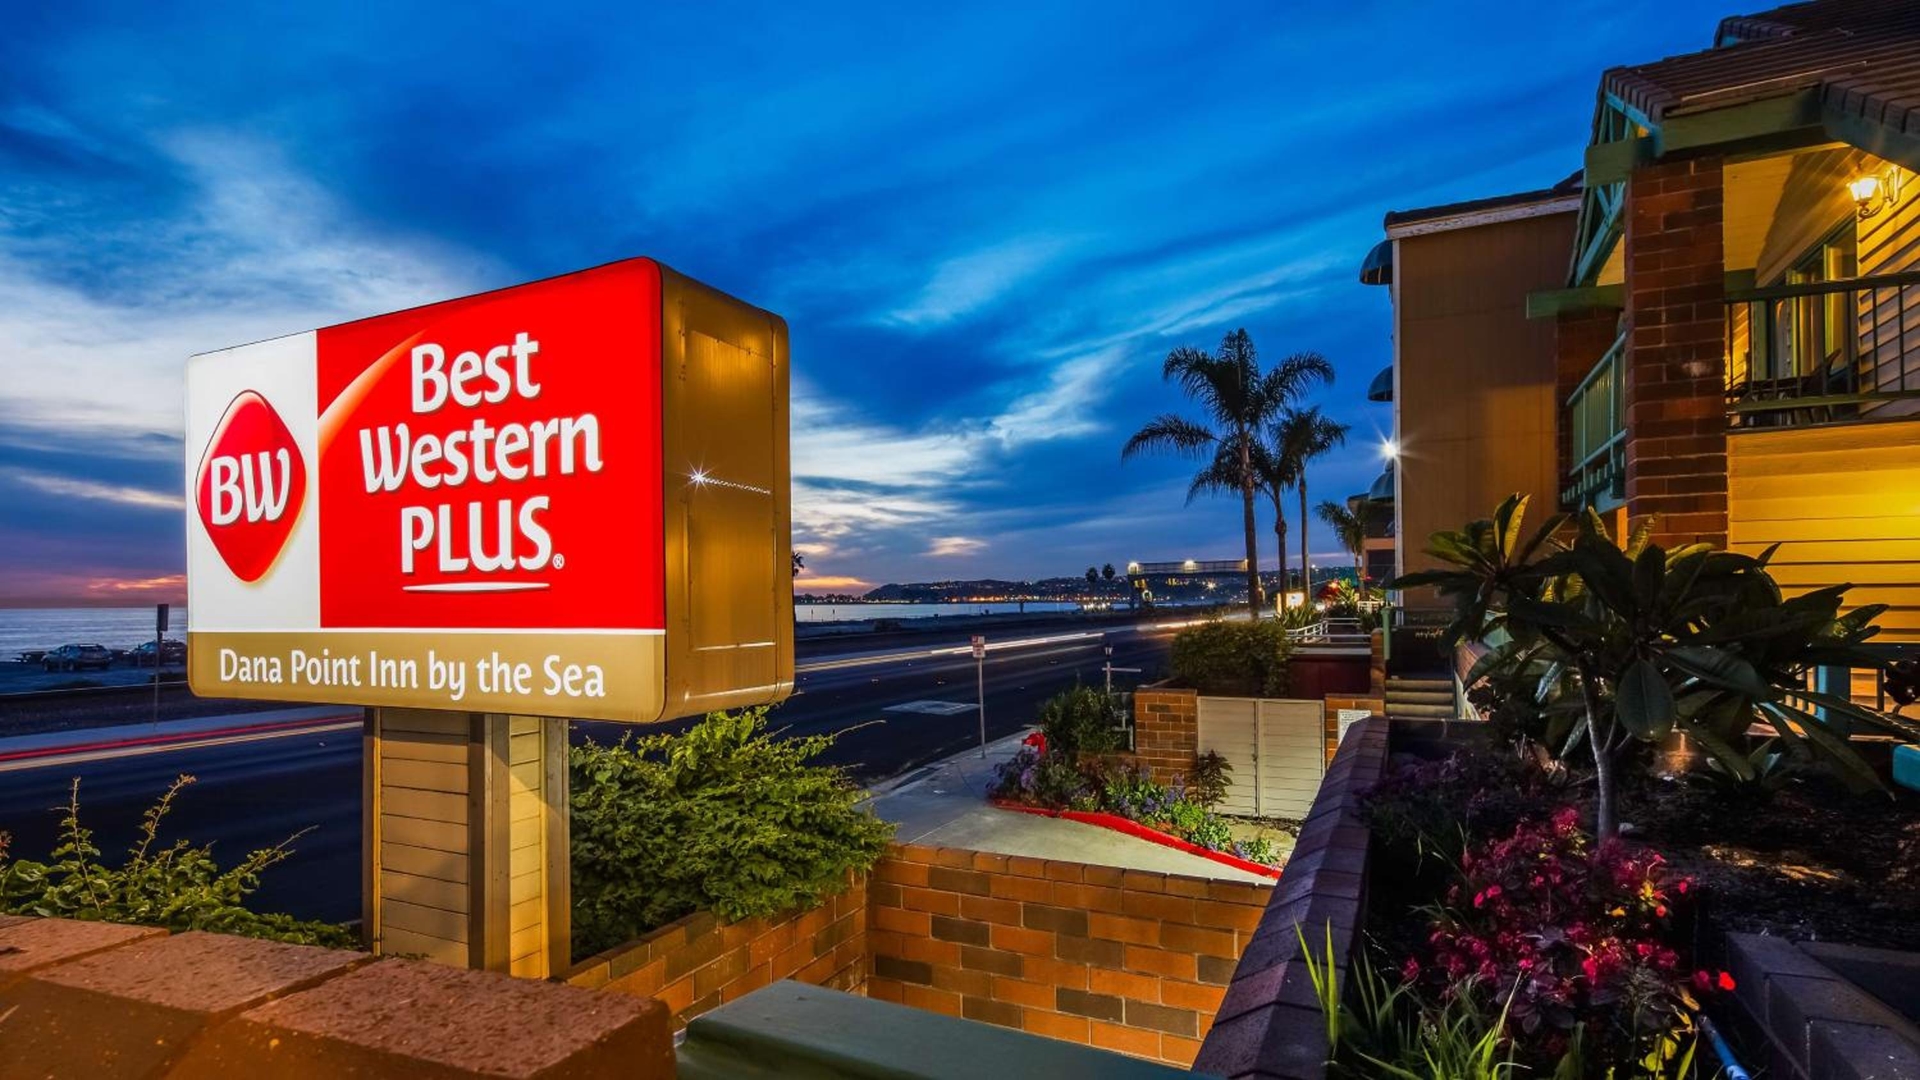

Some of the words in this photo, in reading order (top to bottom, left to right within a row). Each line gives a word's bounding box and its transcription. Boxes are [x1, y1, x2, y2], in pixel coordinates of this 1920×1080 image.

[411, 332, 541, 413] Best
[210, 448, 291, 525] BW
[359, 413, 604, 493] Western
[401, 496, 552, 574] PLUS
[220, 648, 283, 683] Dana
[291, 648, 362, 687] Point
[370, 651, 418, 689] Inn
[428, 650, 466, 701] by
[477, 651, 533, 695] the
[543, 654, 606, 698] Sea
